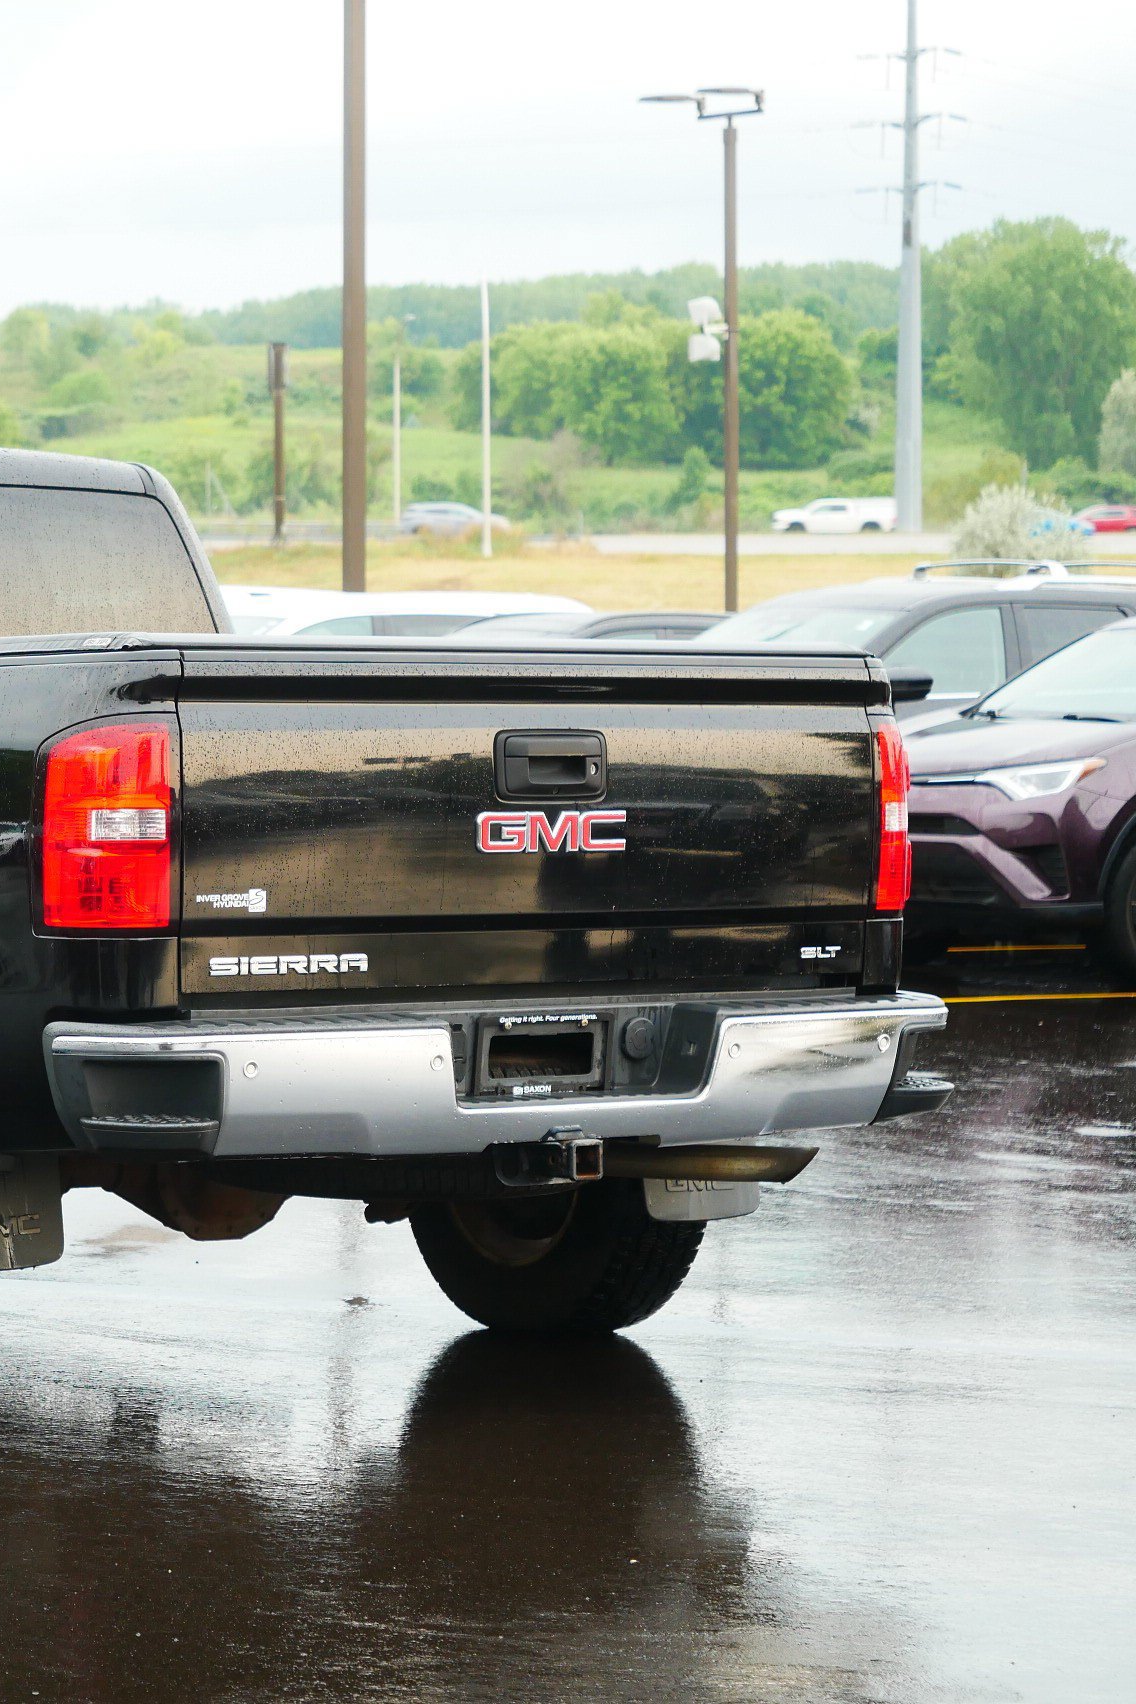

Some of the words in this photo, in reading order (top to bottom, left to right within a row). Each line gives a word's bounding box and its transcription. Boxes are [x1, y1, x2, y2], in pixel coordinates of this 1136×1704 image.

[476, 810, 626, 853] GMC
[196, 894, 220, 903] INVER
[221, 893, 249, 901] GROVE
[213, 900, 249, 909] HYUNDAI
[800, 945, 842, 959] SLT
[209, 953, 368, 976] SIERRA
[499, 1016, 522, 1024] Getting
[545, 1014, 560, 1022] Four
[523, 1085, 552, 1094] SAXON
